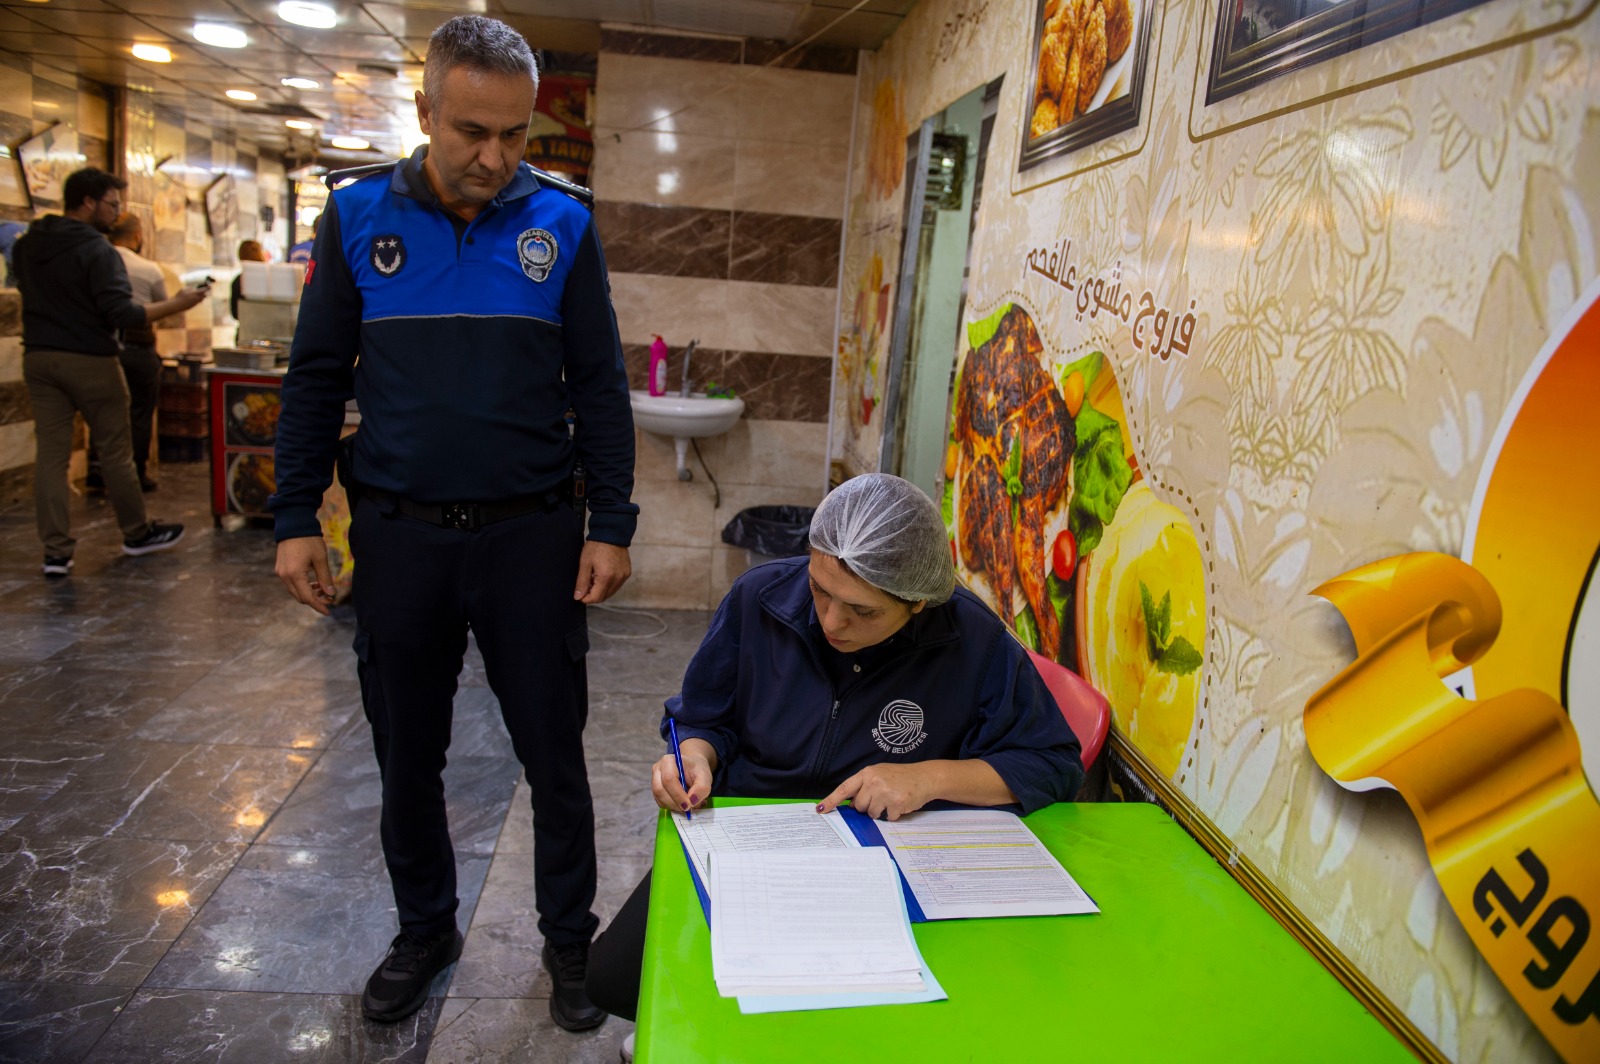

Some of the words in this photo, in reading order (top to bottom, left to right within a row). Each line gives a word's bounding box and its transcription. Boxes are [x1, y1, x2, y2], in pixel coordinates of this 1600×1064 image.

[1075, 260, 1132, 323] مشوي
[1132, 291, 1197, 361] فروج
[1472, 847, 1600, 1026] روج
